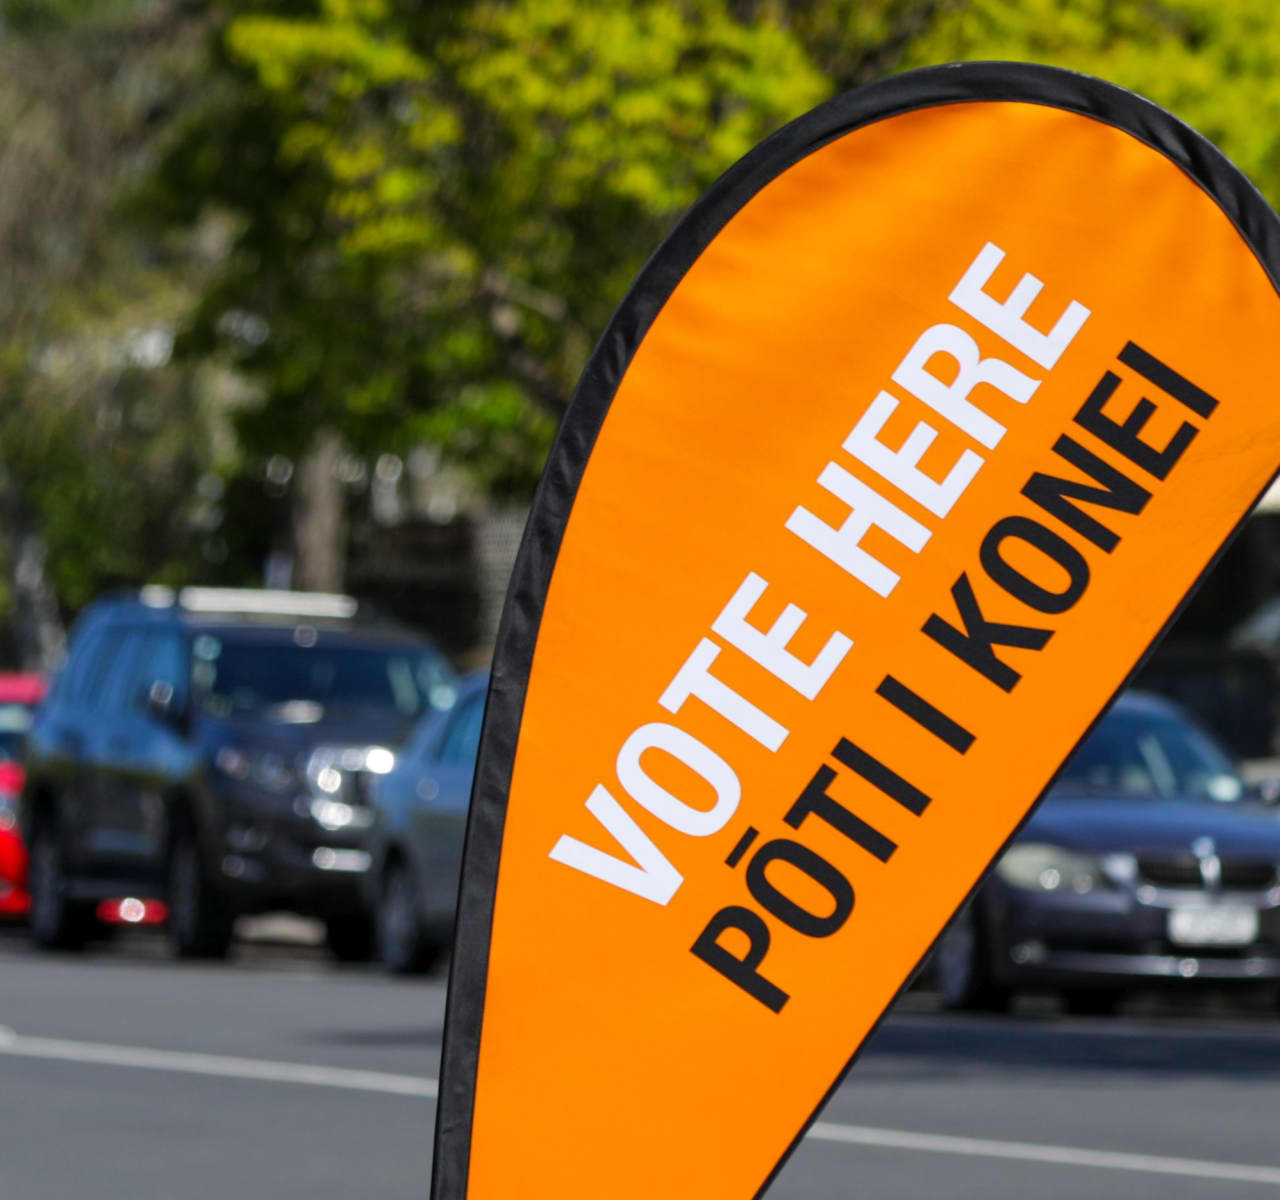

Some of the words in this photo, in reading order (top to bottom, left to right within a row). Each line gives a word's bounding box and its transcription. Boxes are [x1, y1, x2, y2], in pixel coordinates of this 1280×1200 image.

[548, 571, 855, 907] VOTE
[784, 241, 1092, 598] HERE
[921, 340, 1219, 693] KONEI
[875, 674, 976, 755] I
[690, 737, 932, 1014] PŌTI
